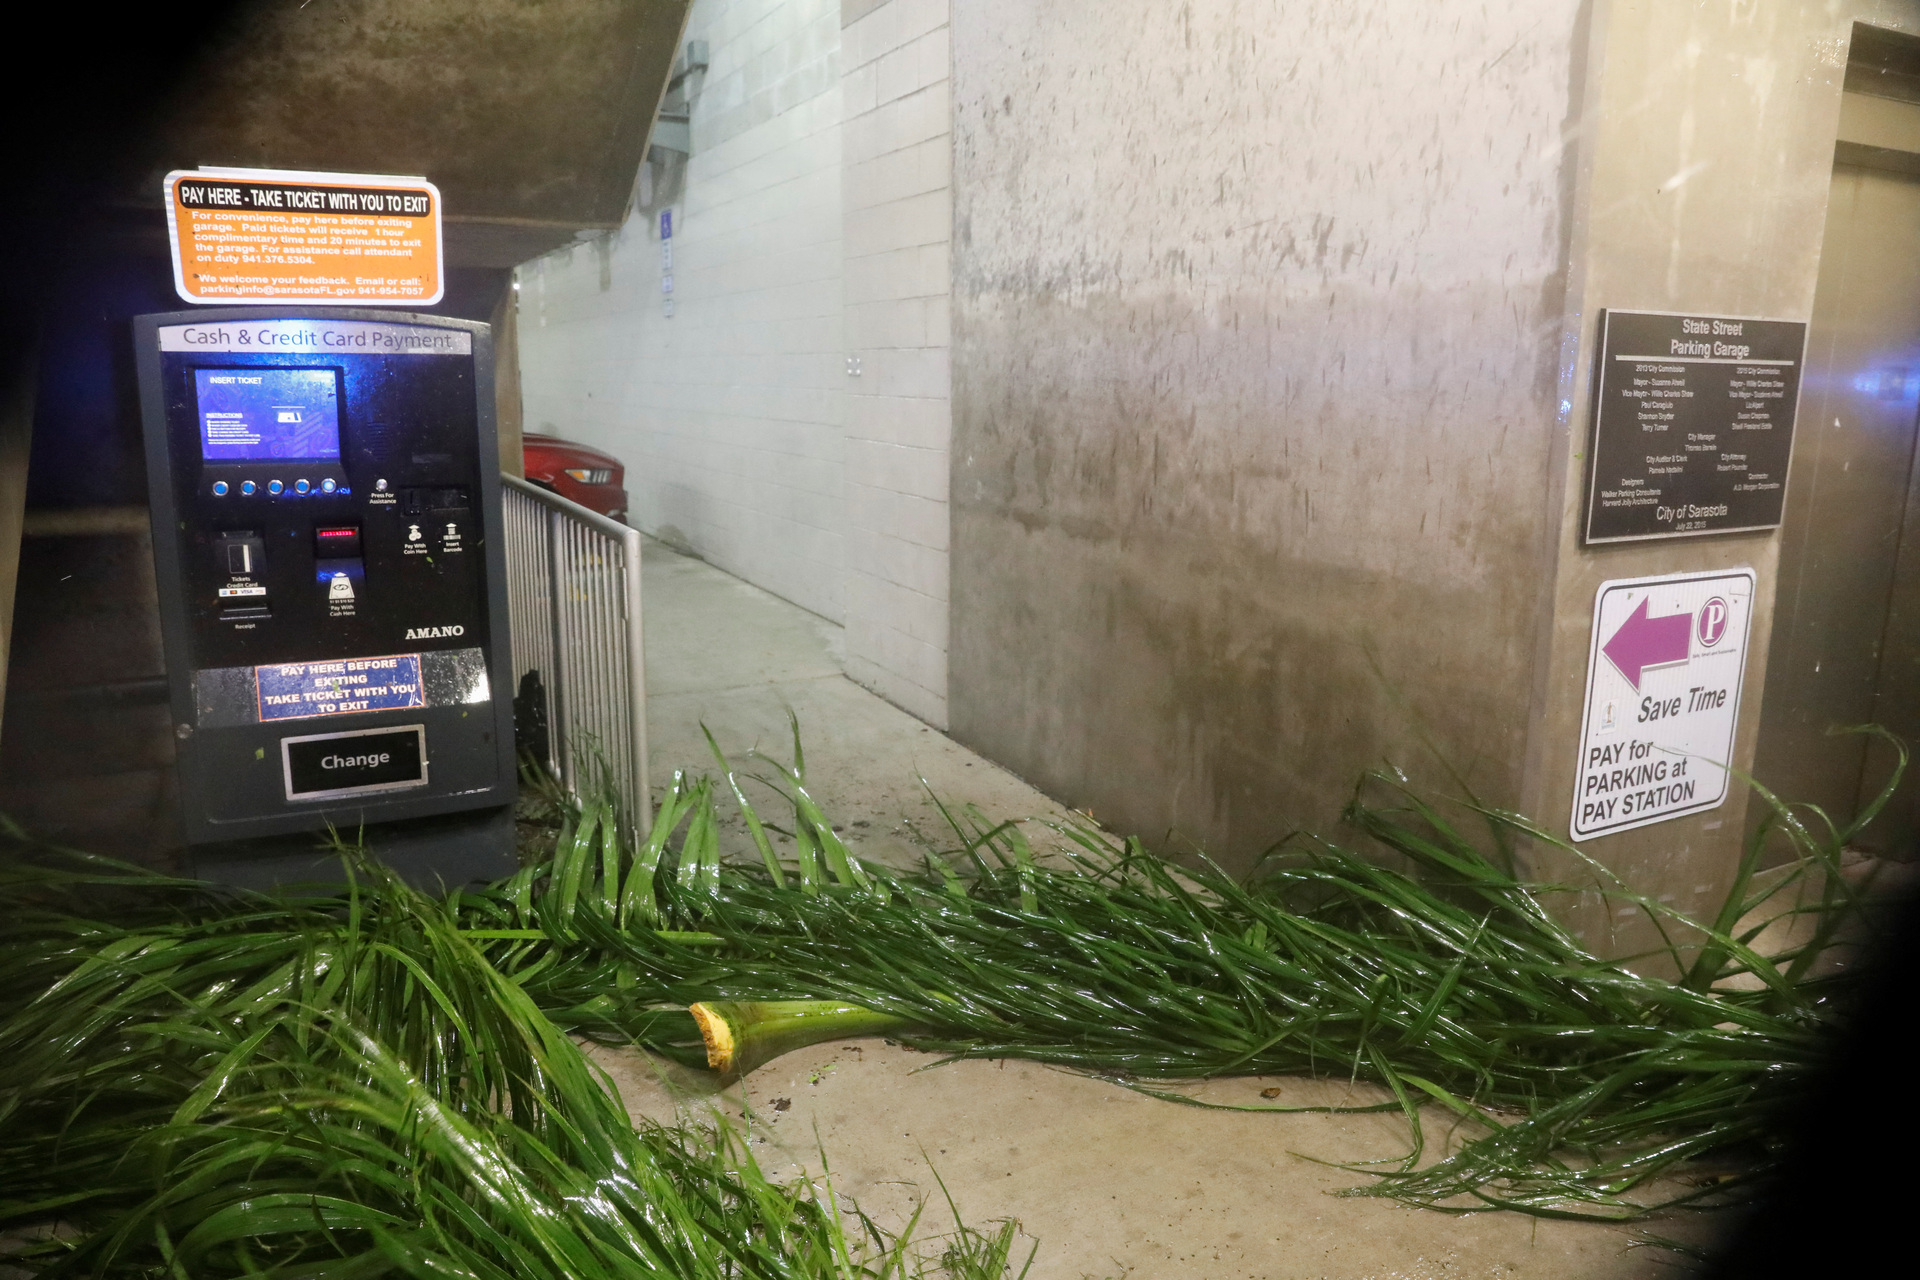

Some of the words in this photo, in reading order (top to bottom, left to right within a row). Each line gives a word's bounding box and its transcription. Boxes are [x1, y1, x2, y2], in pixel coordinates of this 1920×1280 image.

[181, 187, 204, 204] PAY
[208, 188, 242, 205] HERE
[250, 189, 283, 207] TAKE
[284, 191, 326, 209] TICKET
[328, 193, 358, 210] WITH
[359, 194, 384, 211] YOU
[386, 196, 401, 212] TO
[404, 196, 428, 213] EXIT
[192, 211, 212, 220] For
[215, 212, 289, 224] convenience,
[292, 216, 311, 225] pay
[314, 216, 338, 225] here
[341, 217, 375, 226] before
[377, 219, 412, 229] exiting
[193, 224, 236, 233] garage.
[241, 223, 267, 232] Paid
[270, 224, 306, 233] tickets
[308, 226, 327, 234] will
[330, 227, 368, 236] receive
[382, 229, 404, 237] hour
[194, 234, 278, 245] complimentary
[280, 235, 304, 244] time
[330, 237, 342, 245] 20
[345, 238, 387, 246] minutes
[390, 239, 400, 247] to
[403, 239, 421, 247] exit
[195, 243, 214, 252] the
[217, 245, 258, 254] garage.
[261, 244, 280, 253] For
[283, 246, 340, 255] assistance
[343, 247, 361, 255] call
[364, 248, 413, 257] attendant
[215, 254, 239, 264] duty
[242, 255, 315, 264] 941.376.5304.
[199, 274, 217, 283] We
[220, 275, 269, 284] welcome
[271, 277, 296, 285] your
[299, 276, 350, 285] feedback.
[356, 277, 384, 285] Email
[400, 277, 421, 286] call:
[200, 285, 355, 296] parkinginfo@sarasotaFL.gov
[358, 287, 424, 295] 941-954-7057
[1682, 319, 1710, 335] State
[1712, 320, 1743, 336] Street
[183, 328, 230, 344] Cash
[238, 330, 252, 344] &
[258, 329, 318, 346] Credit
[323, 331, 366, 347] Card
[372, 332, 451, 351] Payment
[1671, 339, 1711, 359] Parking
[1713, 341, 1750, 360] Garage
[1648, 365, 1657, 373] City
[238, 377, 263, 385] TICKET
[1646, 456, 1655, 464] City
[1621, 479, 1645, 487] Designers
[1618, 490, 1635, 498] Parking
[1657, 507, 1675, 523] City
[1677, 505, 1688, 519] of
[1688, 504, 1728, 518] Sarasota
[1675, 523, 1686, 531] July
[1704, 604, 1725, 641] P
[405, 625, 465, 640] AMANO
[281, 666, 305, 677] PAY
[309, 662, 345, 674] HERE
[347, 659, 397, 671] BEFORE
[265, 694, 300, 705] TAKE
[303, 689, 351, 702] TICKET
[354, 686, 388, 697] WITH
[390, 684, 416, 695] YOU
[318, 703, 337, 713] TO
[340, 701, 369, 711] EXIT
[1638, 696, 1681, 723] Save
[1687, 686, 1727, 714] Time
[321, 752, 390, 770] Change
[1589, 742, 1625, 769] PAY
[1629, 739, 1653, 761] for
[1585, 760, 1667, 797] PARKING
[1672, 757, 1688, 777] at
[1582, 798, 1623, 825] PAY
[1622, 780, 1696, 815] STATION
